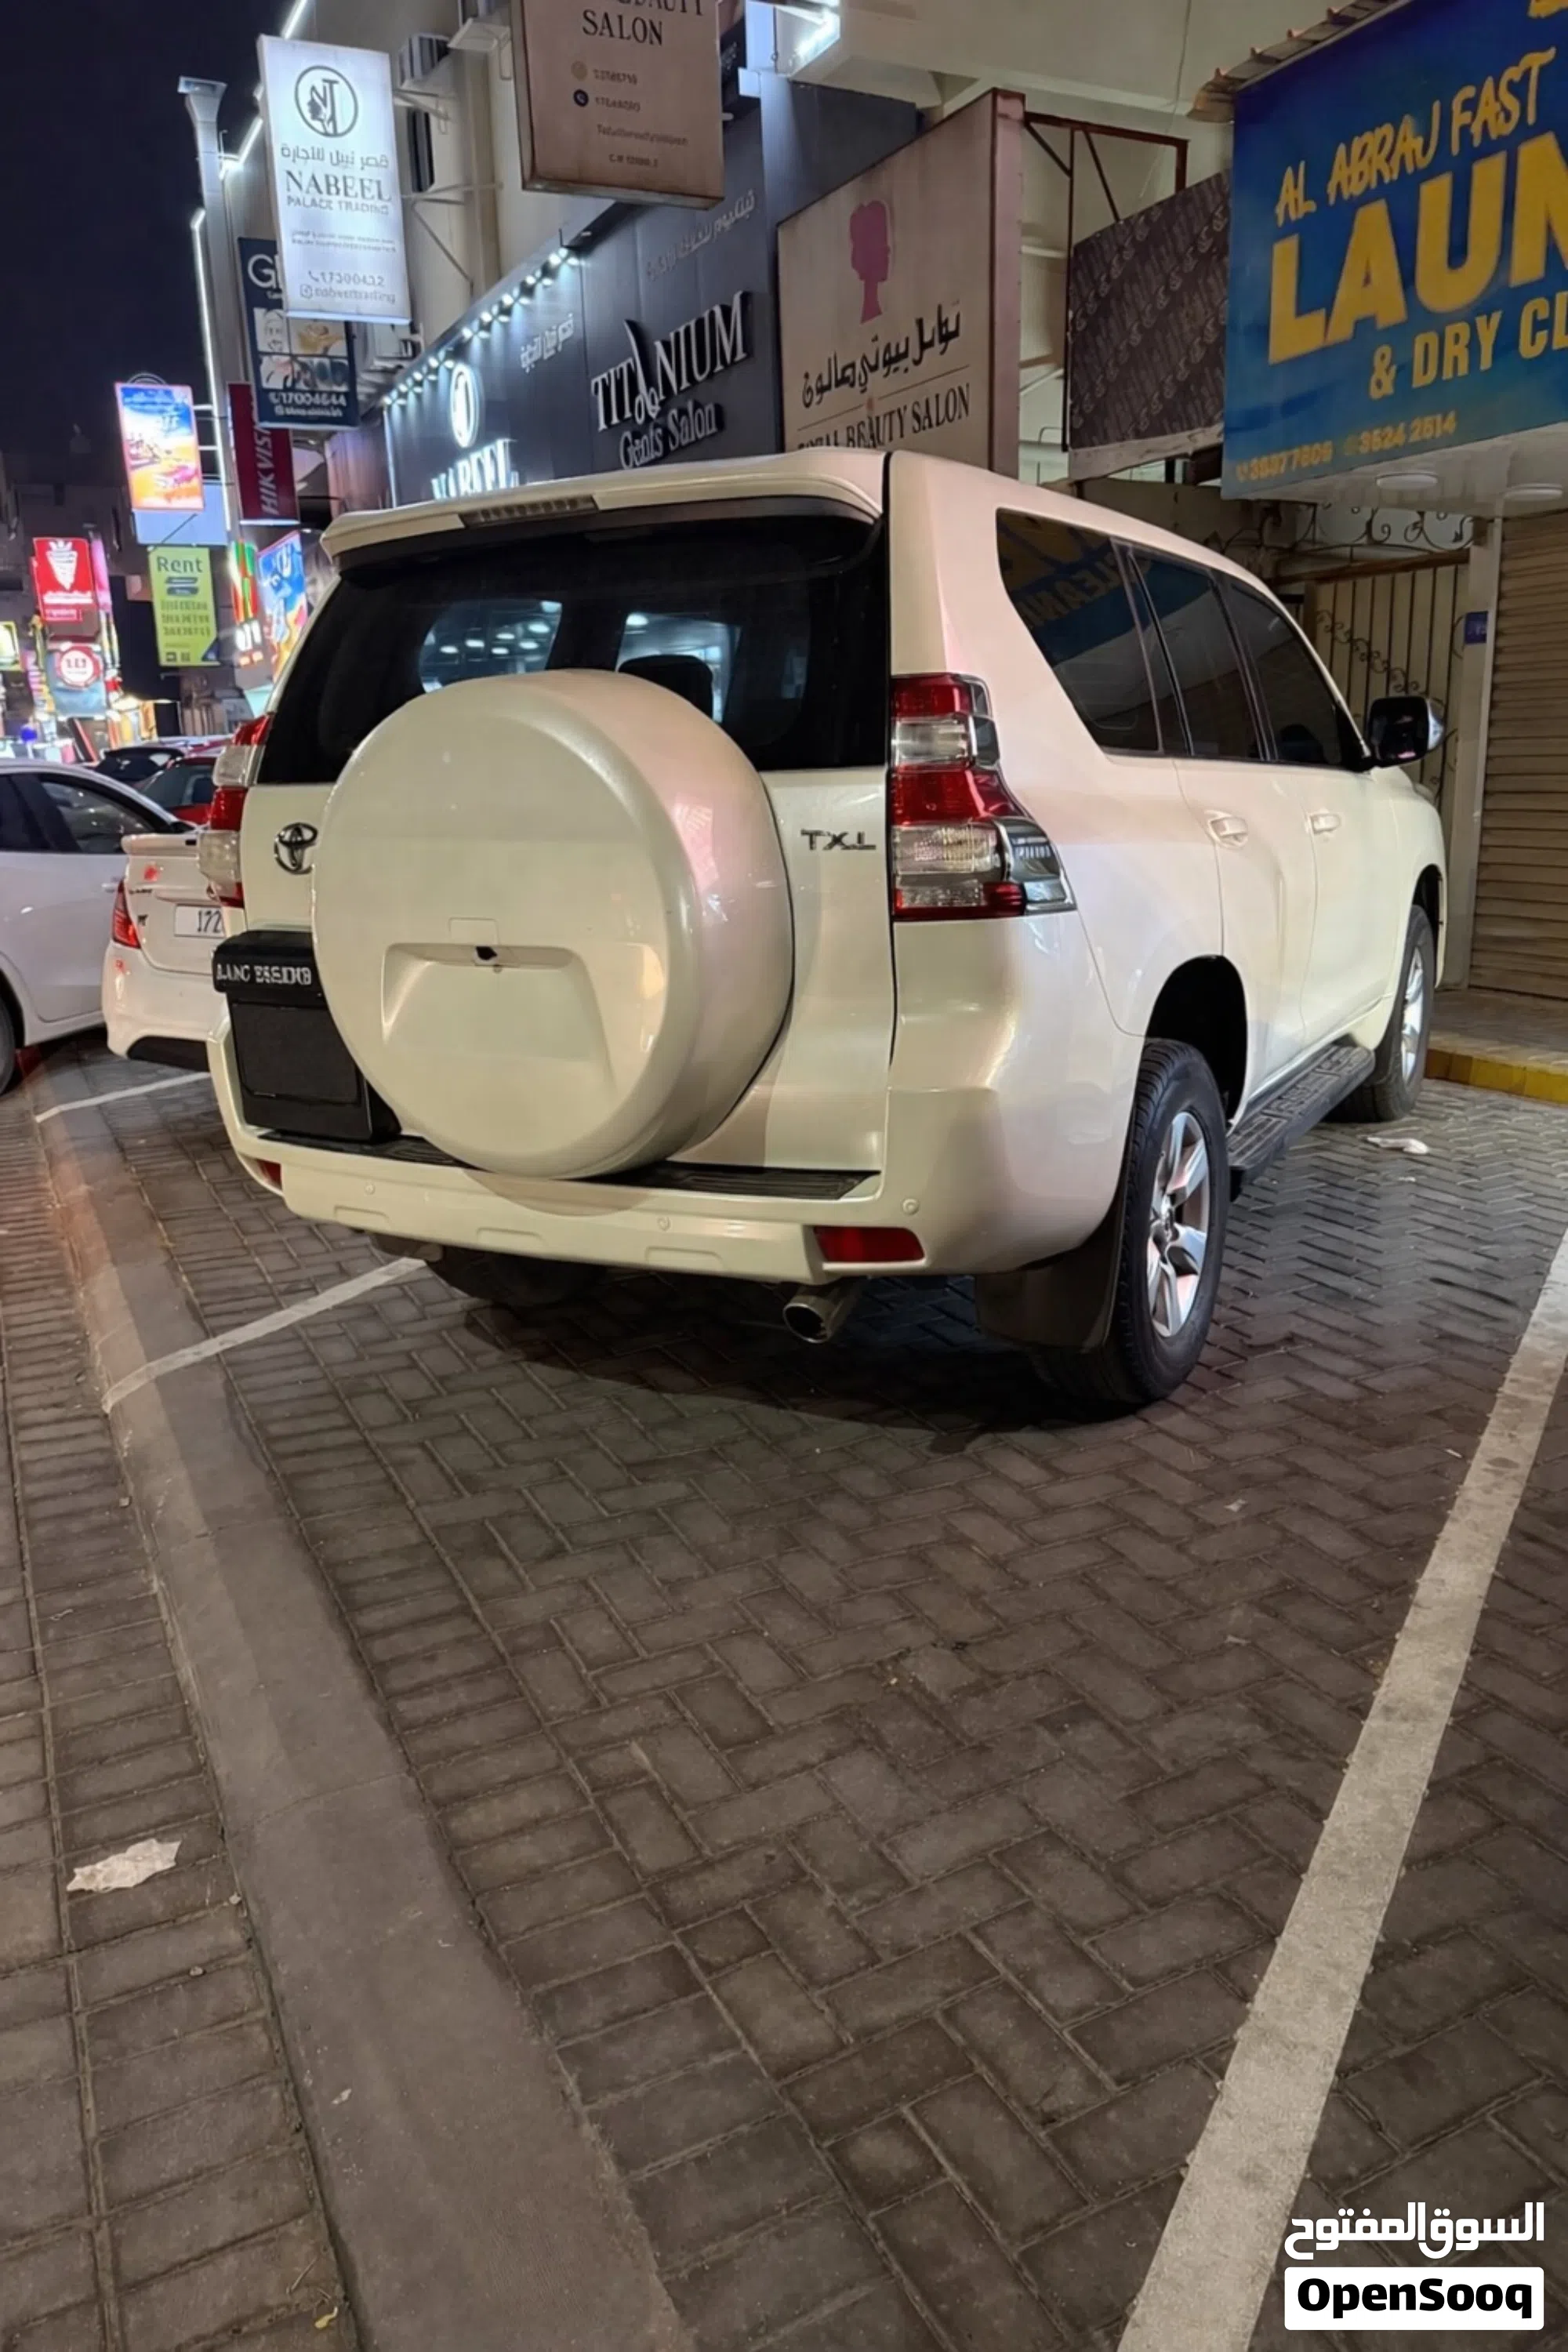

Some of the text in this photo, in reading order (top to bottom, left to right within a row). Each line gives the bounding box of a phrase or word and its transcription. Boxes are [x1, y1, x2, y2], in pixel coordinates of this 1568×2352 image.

[583, 9, 662, 45] SALON
[1275, 45, 1557, 227] AL ABRAJ FAST
[285, 169, 392, 202] NABEEL
[287, 195, 390, 216] PALACE TRADING
[1269, 130, 1568, 366] LAUN
[590, 290, 747, 433] TITANIUM
[1370, 344, 1398, 400] &
[1412, 310, 1502, 389] DRY
[667, 398, 719, 452] Salon
[846, 383, 971, 448] BEAUTY SALON
[157, 556, 203, 574] Rent
[800, 829, 877, 851] TXL
